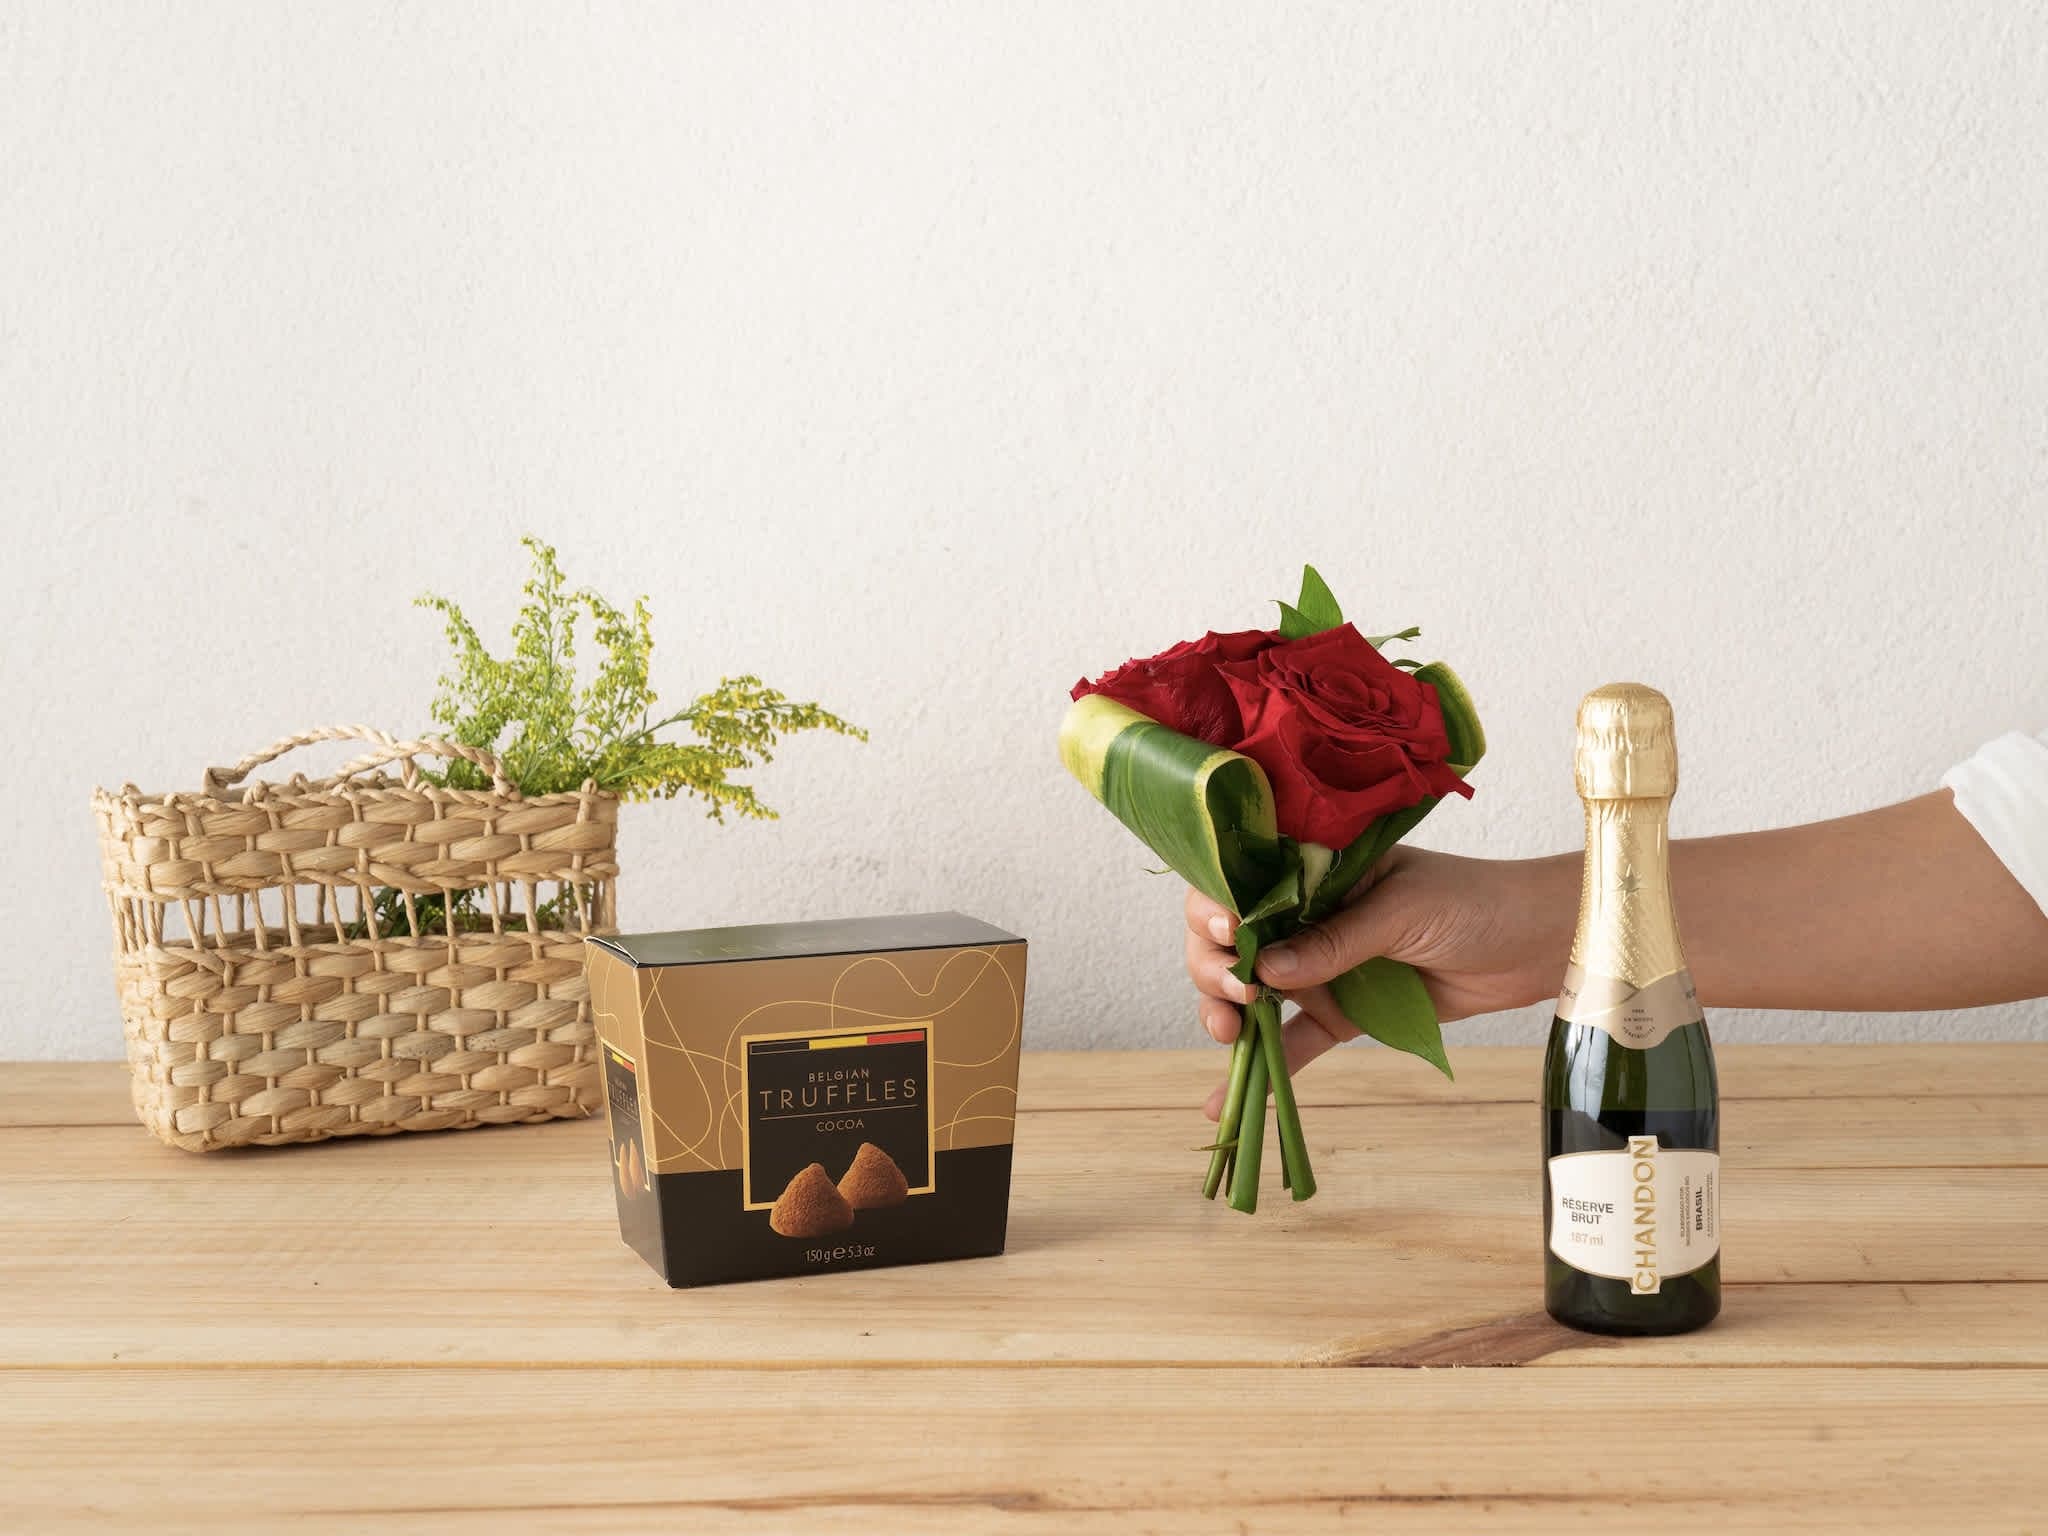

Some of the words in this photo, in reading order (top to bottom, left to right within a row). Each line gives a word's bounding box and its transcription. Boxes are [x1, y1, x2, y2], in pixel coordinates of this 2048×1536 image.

[808, 1069, 870, 1083] BELGIAN
[760, 1078, 918, 1110] TRUFFLES
[816, 1118, 865, 1133] COCOA
[1633, 1139, 1658, 1292] CHANDON
[1695, 1186, 1703, 1231] BRASIL
[1571, 1212, 1602, 1226] BRUT
[805, 1248, 823, 1263] 150
[847, 1245, 863, 1259] 5.3
[864, 1245, 876, 1257] oz
